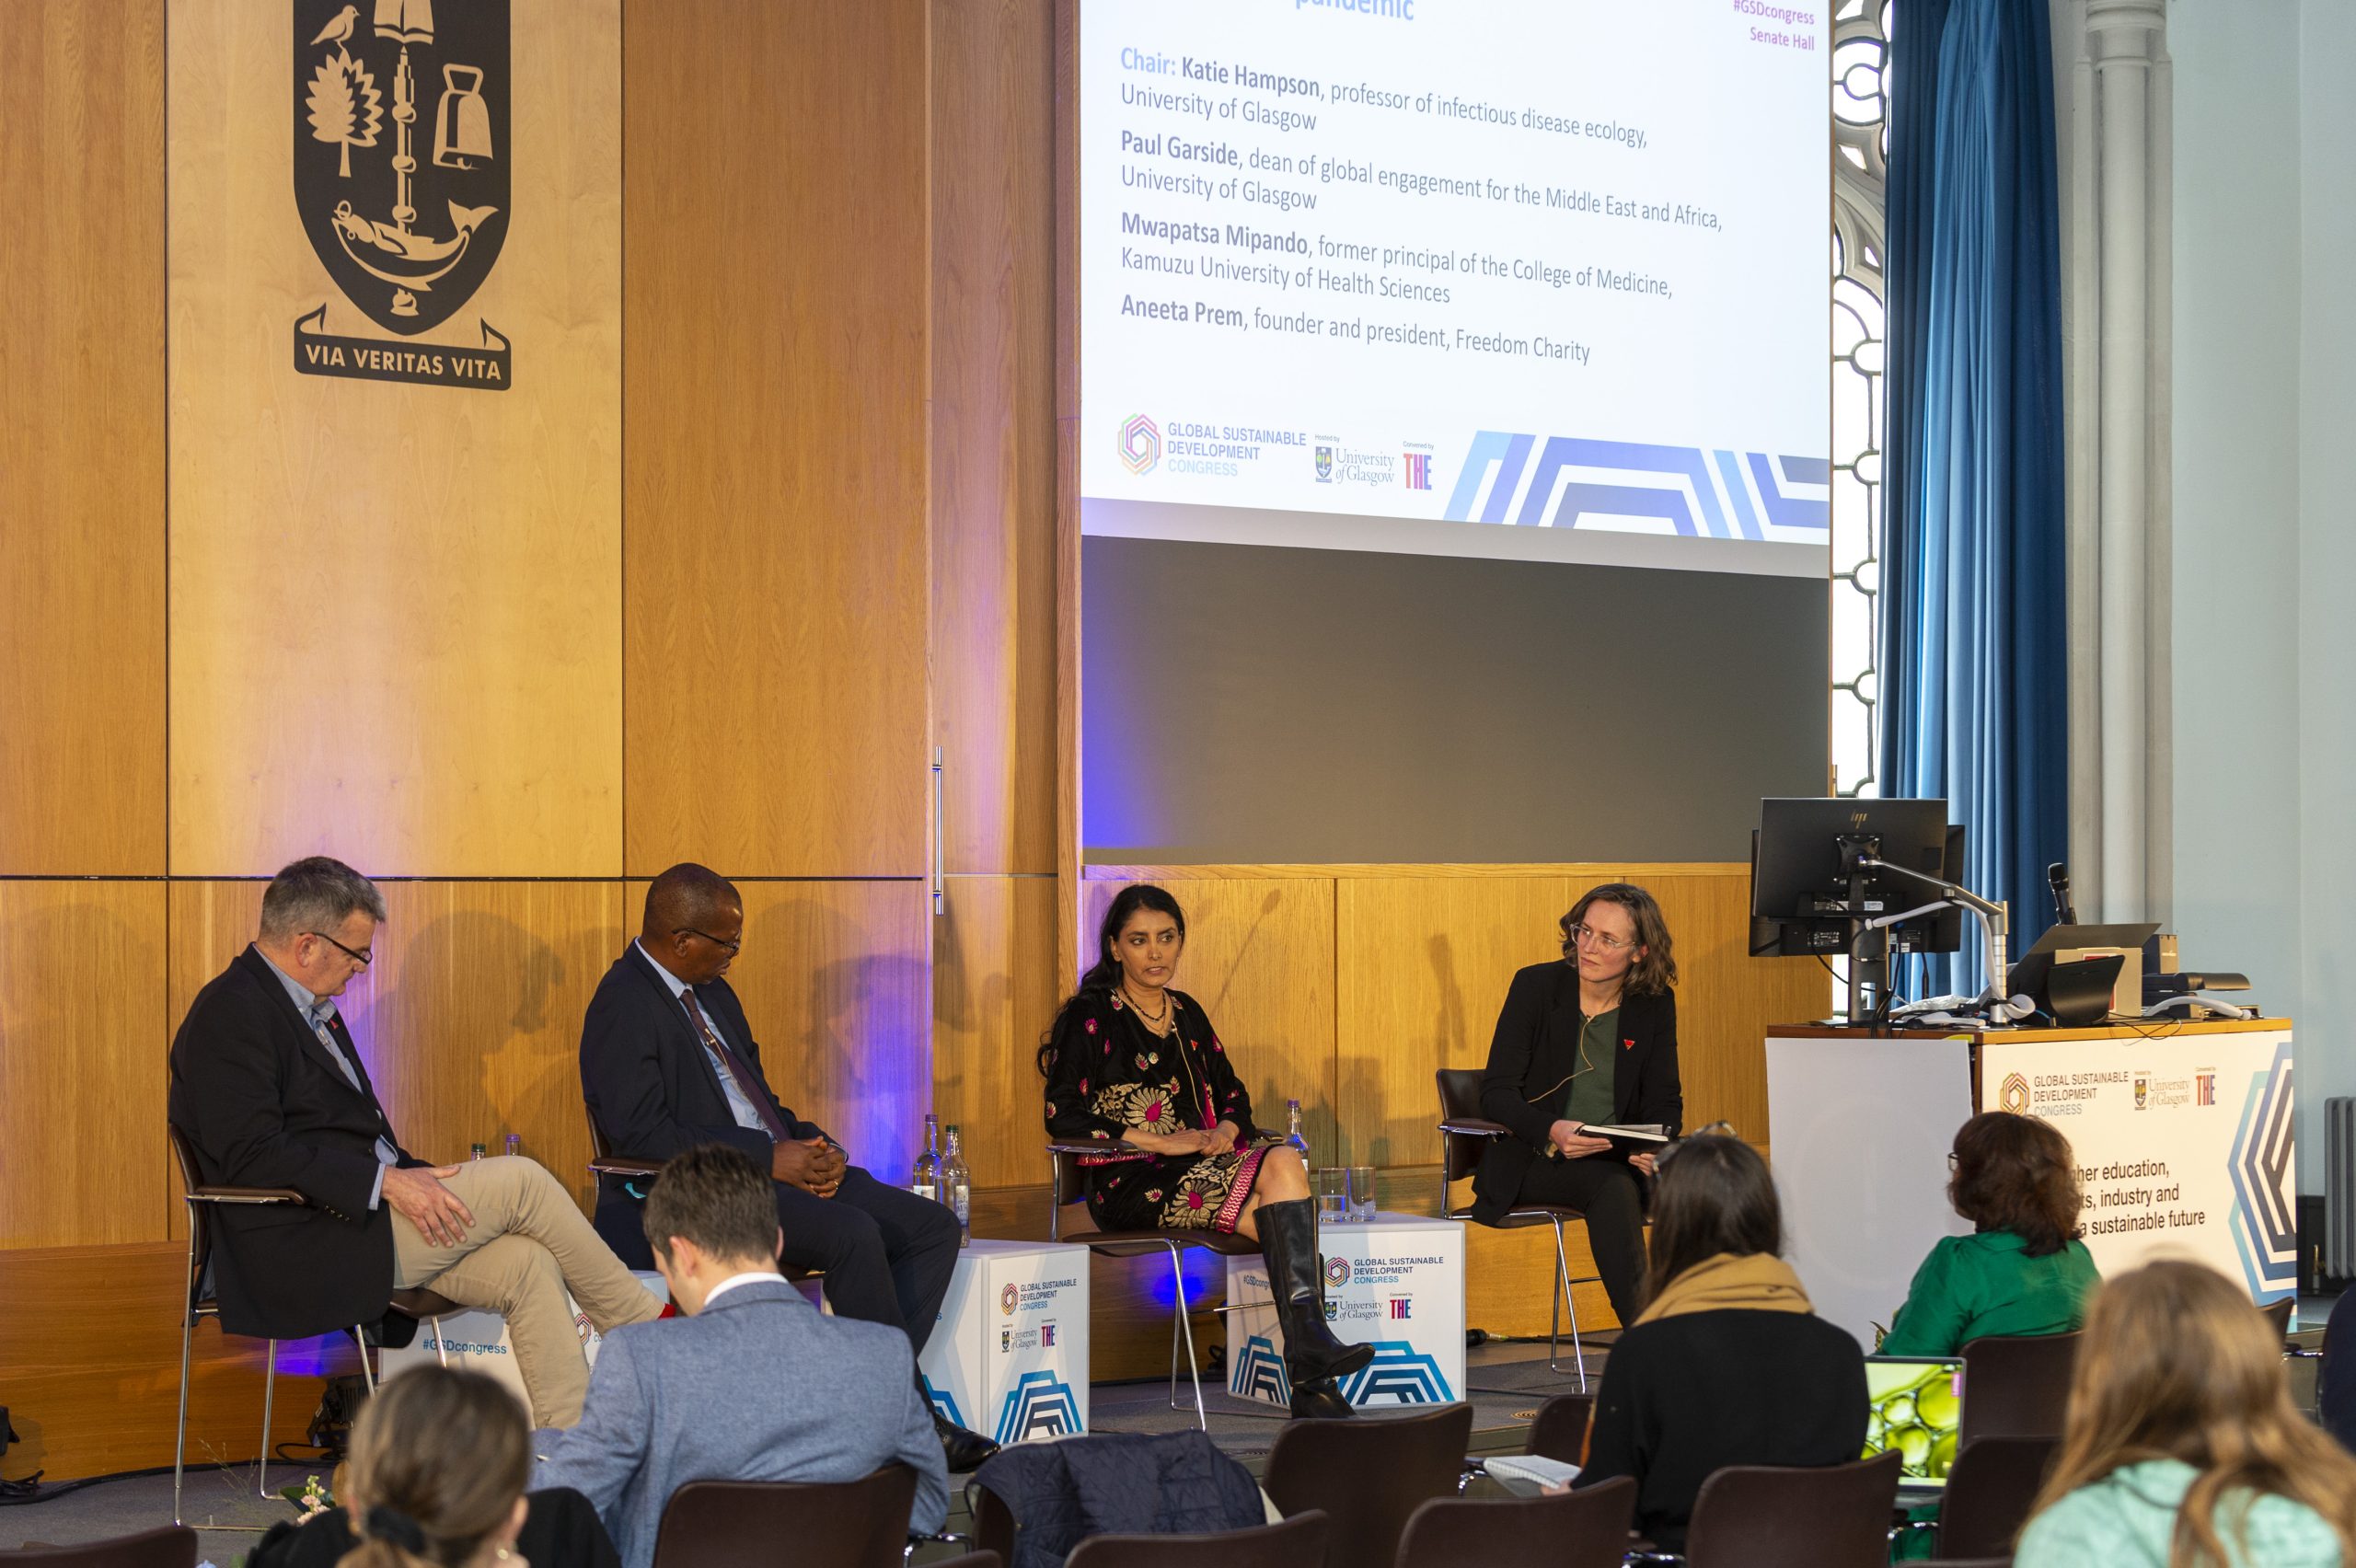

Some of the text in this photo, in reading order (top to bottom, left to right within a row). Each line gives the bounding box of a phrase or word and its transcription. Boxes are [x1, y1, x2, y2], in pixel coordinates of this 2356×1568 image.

[1734, 0, 1815, 25] #GSDcongress
[1750, 27, 1815, 51] Senate Hall
[1121, 47, 1647, 149] Chair: Katie Hampson, professor of infectious disease ecology,
[1122, 83, 1316, 132] University of Glasgow
[1122, 130, 1722, 232] Paul Garside, dean of global engagement for the Middle East and Africa,
[1122, 165, 1317, 212] University of Glasgow
[1122, 212, 1672, 300] Mwapatsa Mipando, former principal of the College of Medicine,
[1122, 247, 1450, 303] Kamuzu University of Health Sciences
[1121, 294, 1590, 366] Aneeta Prem, founder and president, Freedom Charity
[306, 344, 502, 381] VIA VERITAS VITA
[1168, 422, 1307, 446] GLOBAL SUSTAINABLE
[1168, 441, 1260, 460] DEVELOPMENT
[1336, 447, 1394, 471] University
[1168, 458, 1238, 477] CONGRESS
[1335, 464, 1394, 487] of Glasgow
[1403, 453, 1432, 490] THE
[2034, 1071, 2129, 1088] GLOBAL SUSTAINABLE
[2149, 1077, 2190, 1093] University
[2196, 1075, 2215, 1106] THE
[2034, 1088, 2097, 1102] DEVELOPMENT
[2156, 1091, 2189, 1108] Glasgow
[2034, 1103, 2082, 1117] CONGRESS
[2103, 1159, 2169, 1181] education,
[2101, 1187, 2152, 1207] industry
[2156, 1183, 2179, 1203] and
[2080, 1210, 2205, 1236] a sustainable future
[1354, 1266, 1414, 1275] DEVELOPMENT
[1390, 1256, 1444, 1265] SUSTAINABLE
[1021, 1278, 1077, 1292] GLOBAL SUSTAINABLE
[1354, 1276, 1399, 1285] CONGRESS
[1020, 1290, 1057, 1301] DEVELOPMENT
[1020, 1300, 1047, 1311] CONGRESS
[1340, 1300, 1383, 1310] University
[1339, 1309, 1383, 1321] of Glasgow
[1390, 1299, 1412, 1319] THE
[1011, 1328, 1037, 1340] University
[1015, 1339, 1037, 1350] Glasgow
[1042, 1325, 1056, 1347] THE
